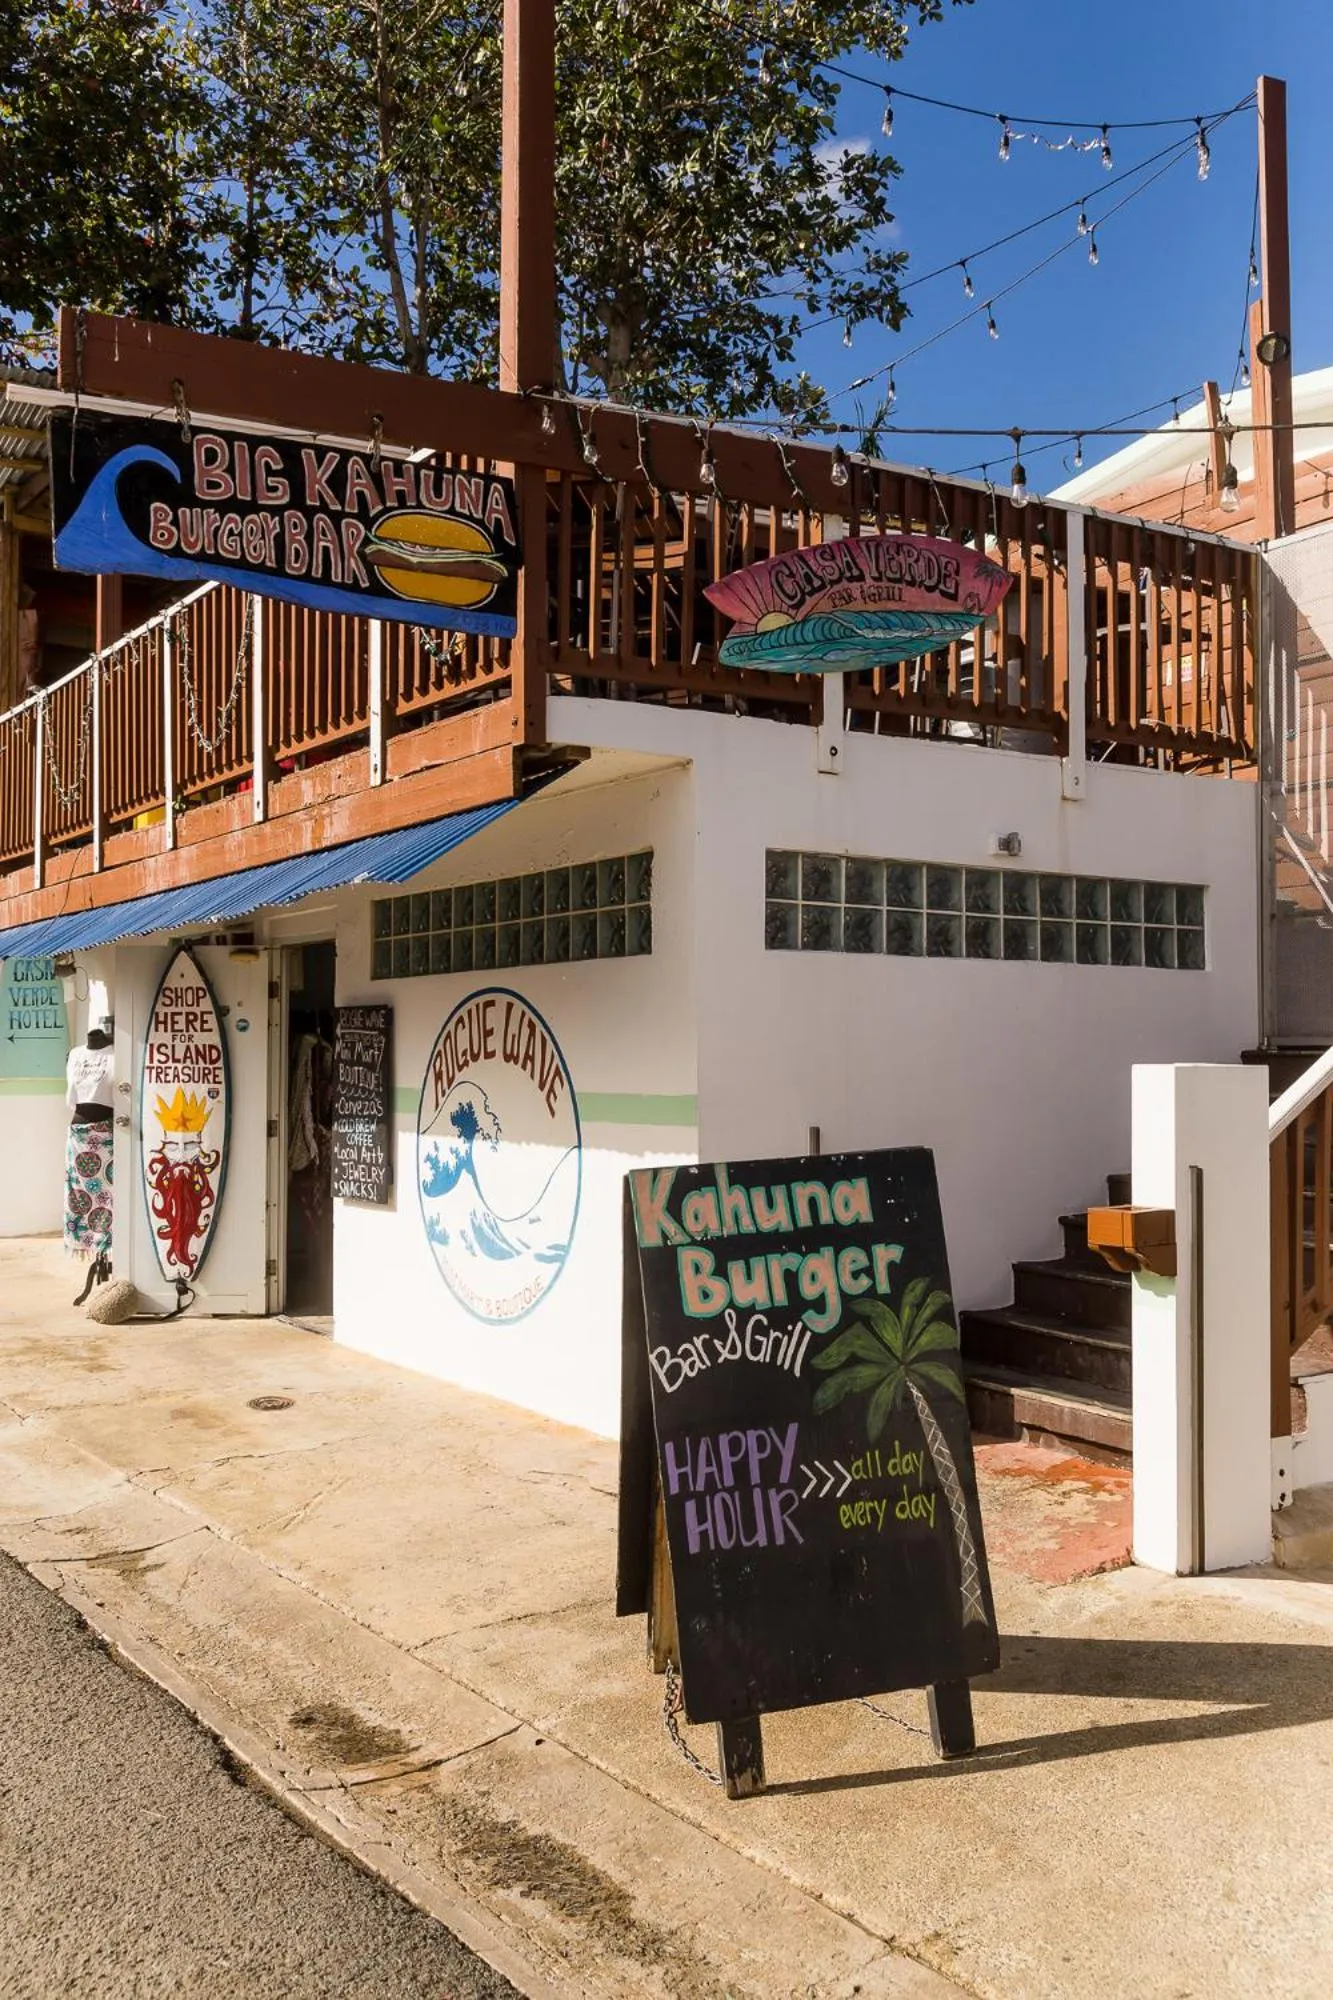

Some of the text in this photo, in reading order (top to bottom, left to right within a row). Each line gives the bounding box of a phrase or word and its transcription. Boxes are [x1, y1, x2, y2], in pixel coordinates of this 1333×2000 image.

[193, 434, 516, 545] BIG KAHUNA
[284, 510, 370, 588] BAR
[769, 539, 961, 610] CASA VERDE
[8, 988, 59, 1007] VERDE
[161, 986, 207, 1008] SHOP
[8, 1010, 64, 1030] HOTEL
[154, 1011, 213, 1033] HERE
[171, 1034, 194, 1044] FOR
[148, 1044, 222, 1066] ISLAND
[432, 999, 564, 1118] ROGUE WAVE
[146, 1066, 223, 1085] TREASURE
[355, 1118, 377, 1133] BREW
[346, 1133, 374, 1147] COFFEE
[342, 1162, 386, 1184] JEWELRY
[629, 1163, 874, 1248] Kahuna
[677, 1243, 904, 1334] Burger
[649, 1308, 812, 1394] Bar & Grill
[664, 1422, 925, 1496] HAPPY all day
[684, 1484, 938, 1555] HOUR every day
